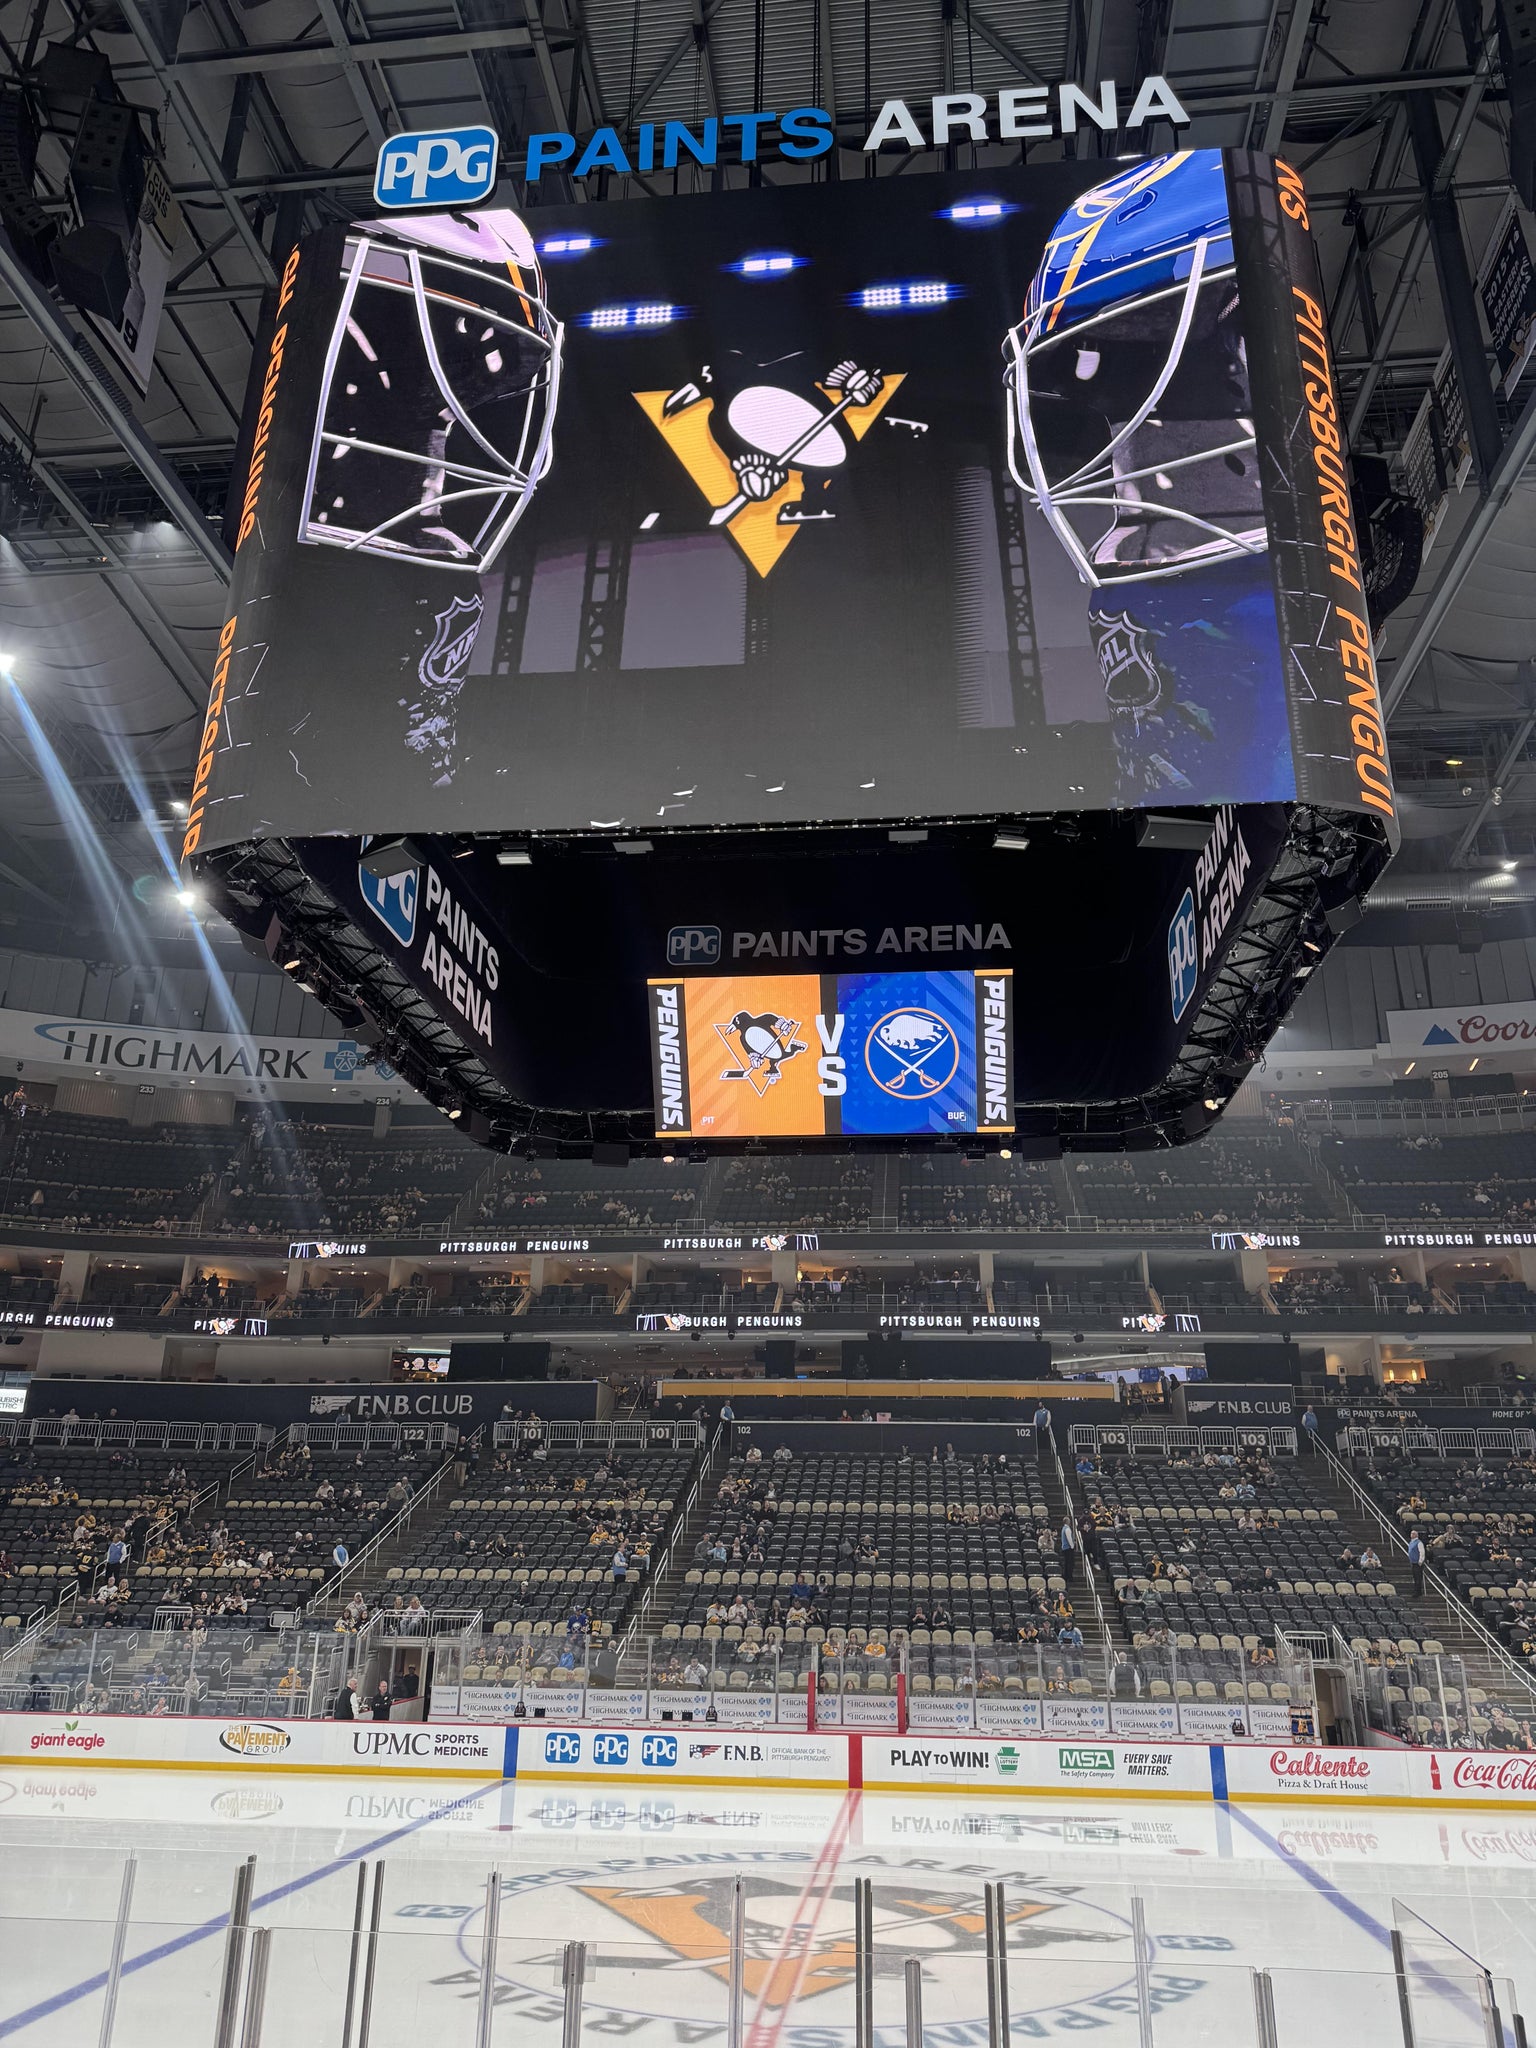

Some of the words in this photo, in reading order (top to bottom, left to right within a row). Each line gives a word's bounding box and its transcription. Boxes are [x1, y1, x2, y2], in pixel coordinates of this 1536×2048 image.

[381, 138, 490, 199] PPG
[525, 109, 834, 181] PAINTS
[863, 76, 1191, 151] ARENA
[1292, 286, 1361, 591] PITTSBURGH
[1336, 605, 1394, 818] PENGUI
[1202, 822, 1251, 972] ARENA
[426, 864, 499, 991] PAINTS
[670, 929, 718, 960] PPG
[732, 928, 868, 958] PAINTS
[875, 923, 1012, 953] ARENA
[1171, 911, 1195, 1002] PPG
[421, 931, 493, 1047] ARENA
[1457, 1015, 1536, 1044] Coor
[63, 1030, 312, 1080] HIGHMARK
[983, 978, 1008, 1122] PENGUINS
[656, 986, 684, 1128] PENGUINS
[1433, 1071, 1449, 1080] 205
[139, 1085, 155, 1095] 233
[375, 1097, 391, 1106] 234
[702, 1115, 715, 1125] PIT
[947, 1112, 966, 1121] BUF
[664, 1238, 742, 1249] PITTSBURGH
[1385, 1234, 1474, 1246] PITTSBURGH
[439, 1241, 517, 1252] PITTSBURGH
[526, 1240, 589, 1251] PENGUINS
[45, 1315, 115, 1328] PENGUINS
[737, 1315, 802, 1327] PENGUINS
[880, 1315, 962, 1327] PITTSBURGH
[972, 1315, 1041, 1328] PENGUINS
[416, 1394, 473, 1415] CLUB
[1255, 1401, 1291, 1414] CLUB
[1352, 1410, 1385, 1418] PAINTS
[1387, 1410, 1418, 1418] ARENA
[1492, 1410, 1514, 1418] HOME
[1515, 1410, 1525, 1418] OF
[404, 1429, 424, 1441] 122
[523, 1428, 542, 1439] 101
[651, 1427, 670, 1438] 101
[737, 1426, 751, 1434] 102
[1015, 1428, 1031, 1437] 102
[1101, 1432, 1125, 1445] 103
[1241, 1433, 1266, 1446] 103
[1374, 1435, 1400, 1447] 104
[467, 1692, 503, 1700] HIGHMARK
[529, 1693, 565, 1701] HIGHMARK
[593, 1694, 628, 1702] HIGHMARK
[721, 1697, 757, 1705] HIGHMARK
[467, 1704, 502, 1712] HIGHMARK
[592, 1706, 628, 1714] HIGHMARK
[851, 1700, 887, 1709] HIGHMARK
[917, 1702, 954, 1710] HIGHMARK
[984, 1704, 1021, 1712] HIGHMARK
[1051, 1706, 1089, 1714] HIGHMARK
[720, 1710, 757, 1718] HIGHMARK
[850, 1713, 887, 1721] HIGHMARK
[1118, 1708, 1157, 1716] HIGHMARK
[1187, 1709, 1226, 1717] HIGHMARK
[917, 1715, 955, 1723] HIGHMARK
[984, 1717, 1022, 1725] HIGHMARK
[1051, 1719, 1089, 1727] HIGHMARK
[1119, 1721, 1158, 1729] HIGHMARK
[1188, 1722, 1227, 1730] HIGHMARK
[31, 1732, 65, 1750] giant
[67, 1733, 105, 1751] eagle
[227, 1726, 287, 1752] PAVEMENT
[353, 1732, 430, 1755] UPMC
[434, 1734, 479, 1745] SPORTS
[434, 1746, 488, 1757] MEDICINE
[546, 1735, 579, 1762] PPG
[594, 1736, 628, 1764] PPG
[643, 1738, 677, 1764] PPG
[724, 1745, 764, 1761] F.N.B.
[891, 1750, 932, 1766] PLAY
[933, 1754, 949, 1765] TO
[950, 1751, 990, 1768] WIN!
[1062, 1751, 1112, 1768] MSA
[1124, 1753, 1150, 1764] EVERY
[1150, 1754, 1173, 1765] SAVE
[1270, 1750, 1371, 1777] Caliente
[1071, 1770, 1088, 1779] Safety
[1089, 1770, 1115, 1779] Company
[1128, 1765, 1169, 1776] MATTERS.
[1278, 1778, 1302, 1788] Pizza
[1303, 1779, 1311, 1788] &
[1314, 1779, 1338, 1789] Draft
[1340, 1780, 1369, 1790] House
[603, 1851, 815, 1872] PAINTS
[849, 1854, 1087, 1896] ARENA
